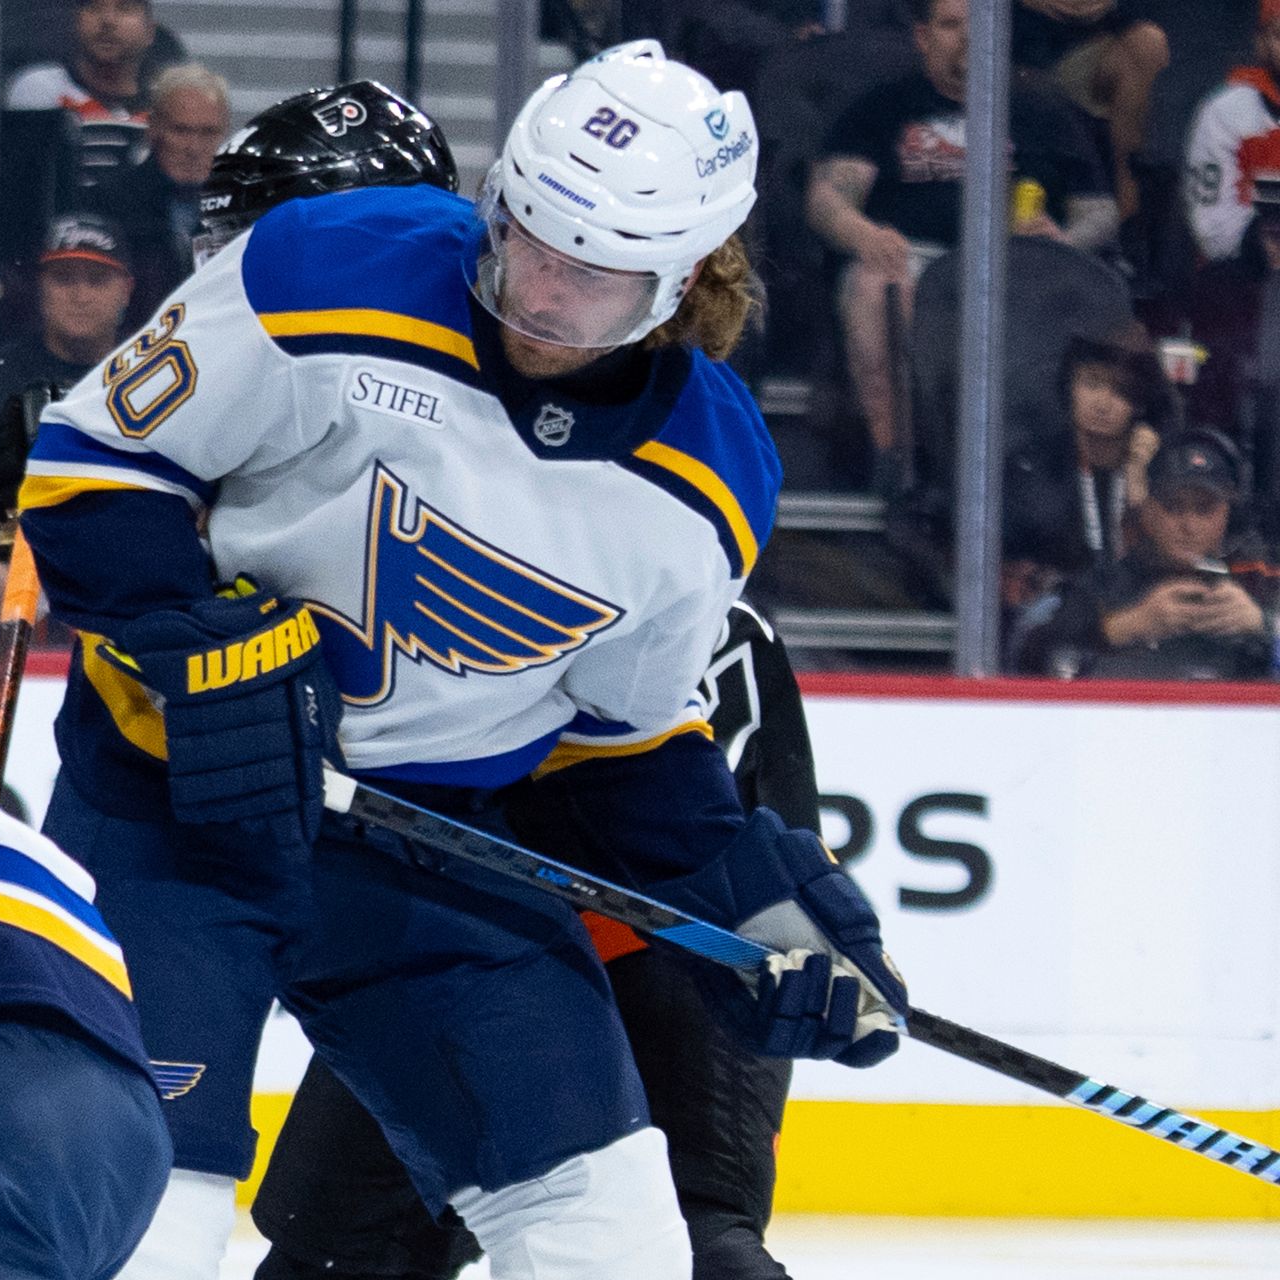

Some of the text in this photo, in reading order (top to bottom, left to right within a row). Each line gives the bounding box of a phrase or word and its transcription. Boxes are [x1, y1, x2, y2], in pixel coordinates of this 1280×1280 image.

[582, 107, 640, 150] 20
[537, 171, 598, 212] WARRIOR
[352, 372, 443, 425] STIFEL
